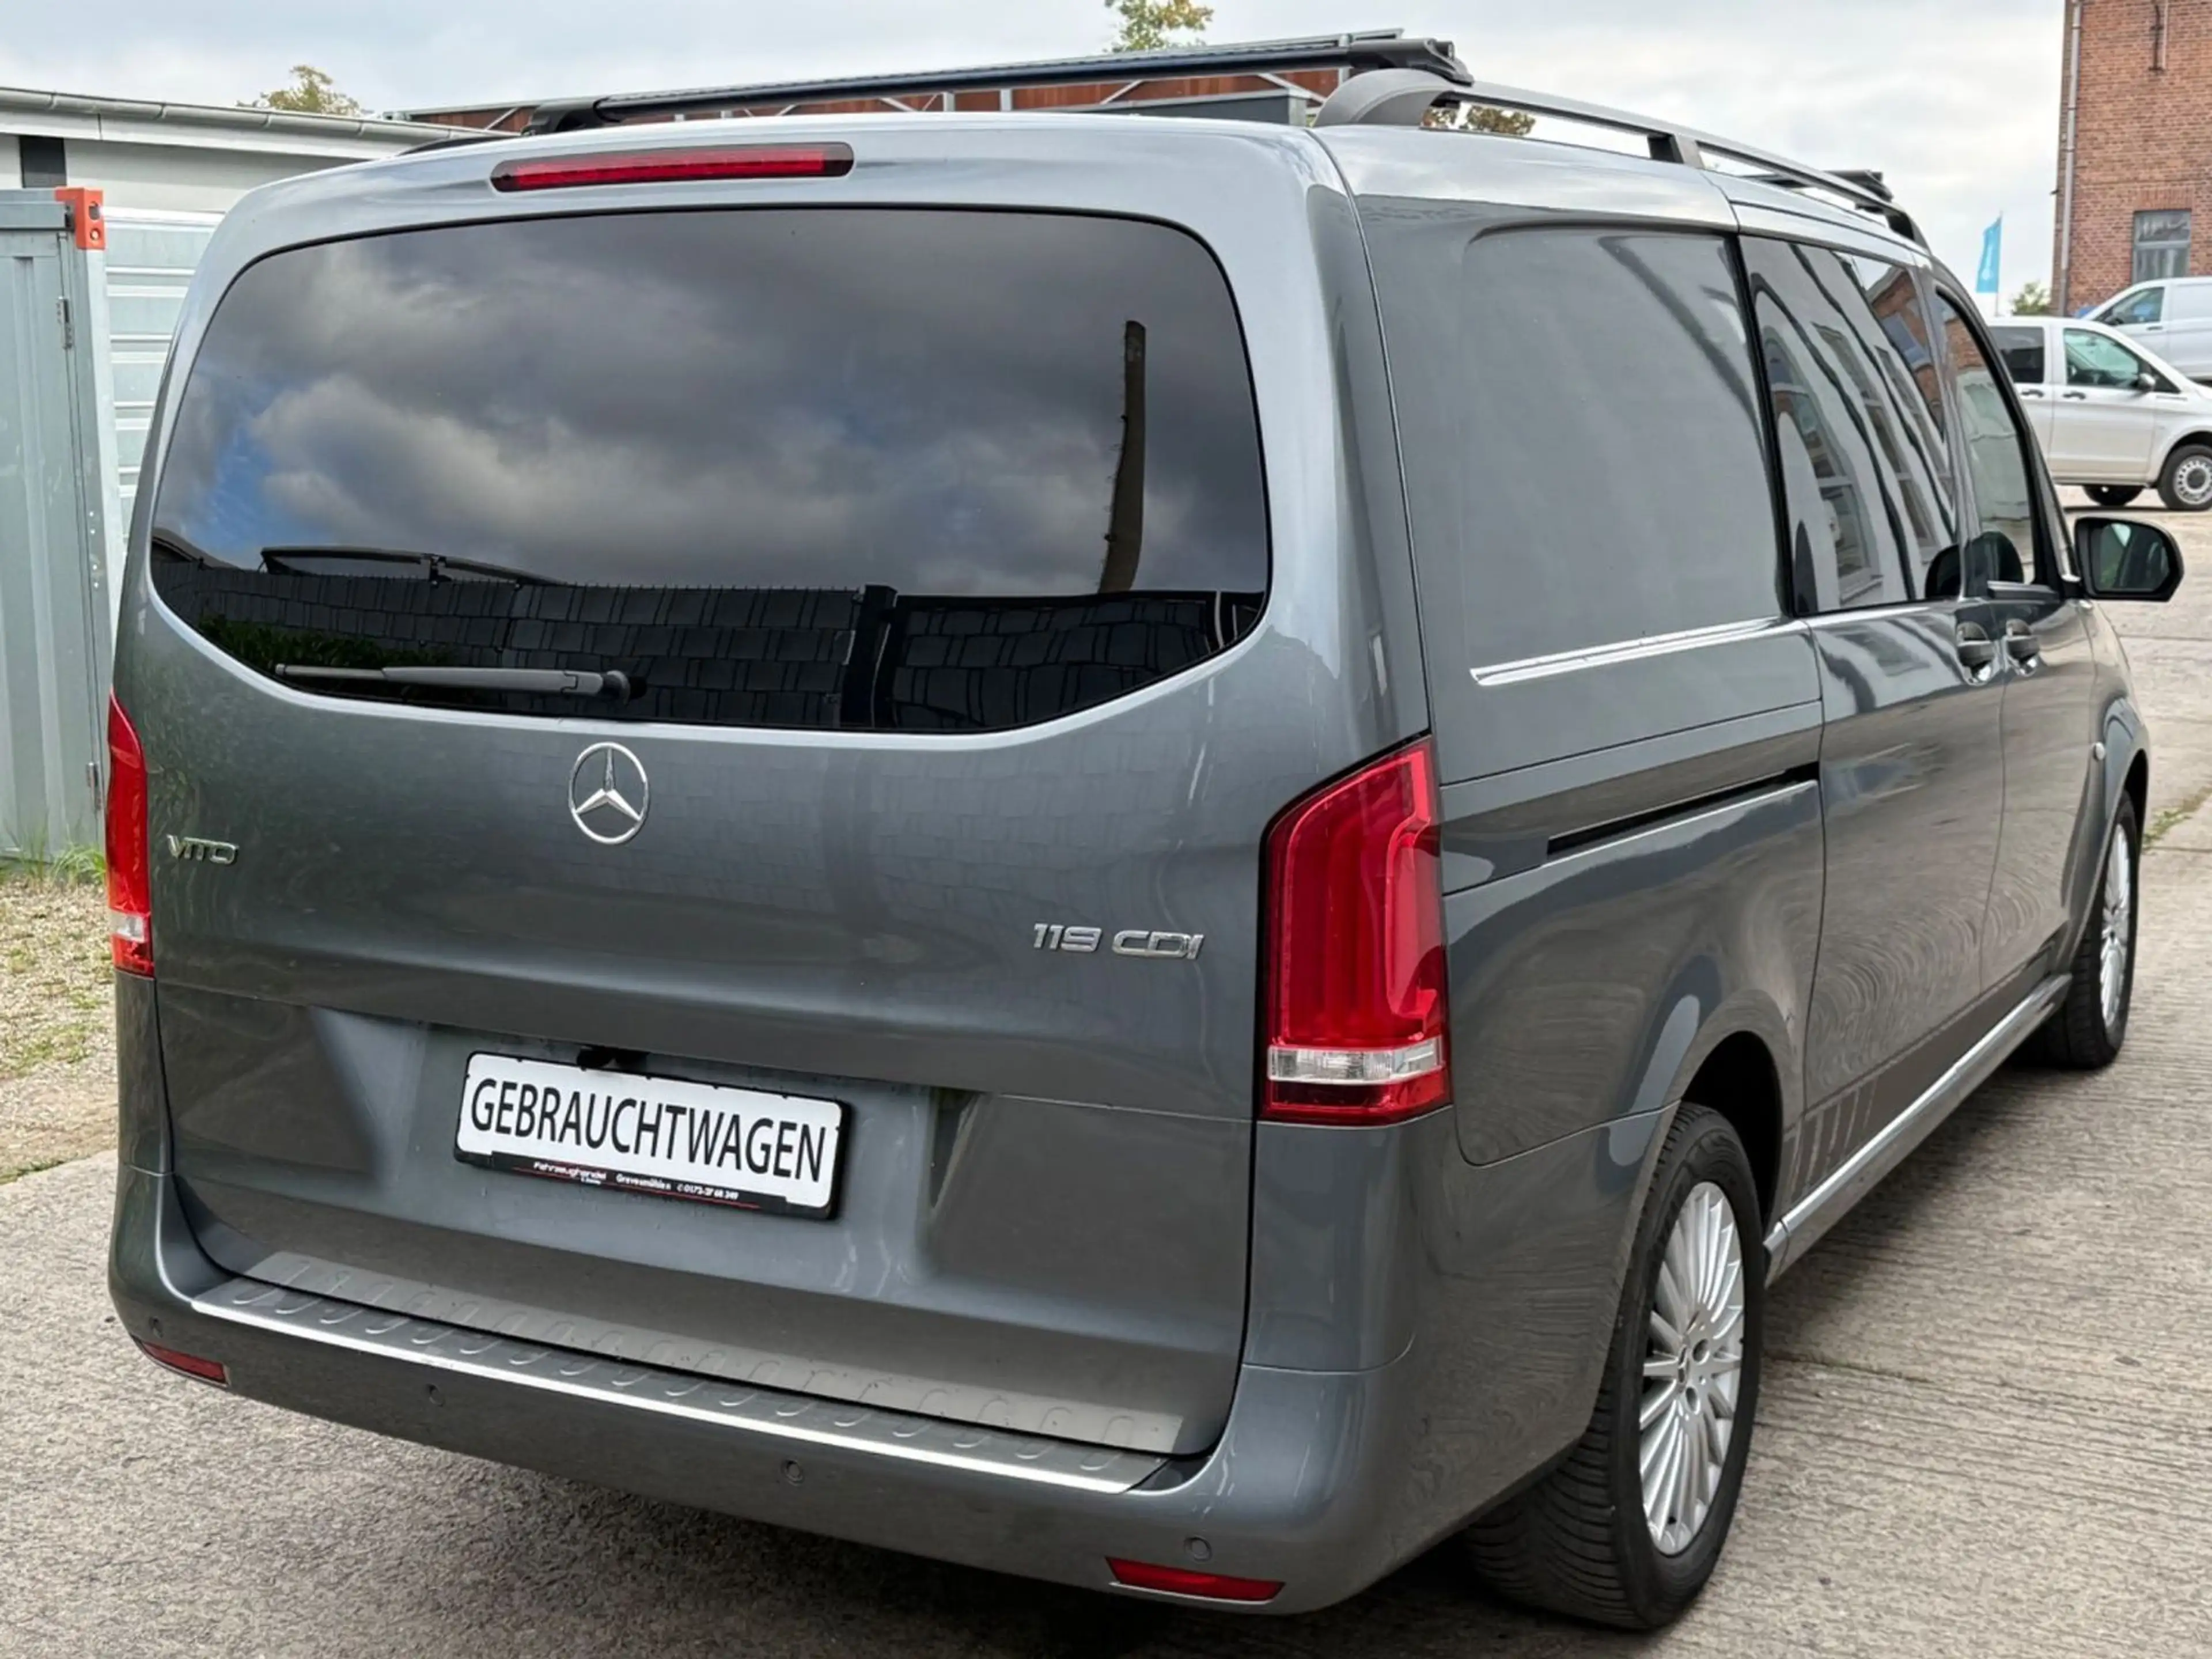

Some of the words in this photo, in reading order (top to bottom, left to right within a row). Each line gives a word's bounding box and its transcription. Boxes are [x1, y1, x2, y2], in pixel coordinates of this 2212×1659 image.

[166, 835, 238, 864] VITO
[1034, 923, 1101, 952] 119
[1112, 930, 1204, 959] CDI
[471, 1078, 825, 1181] GEBRAUCHTWAGEN
